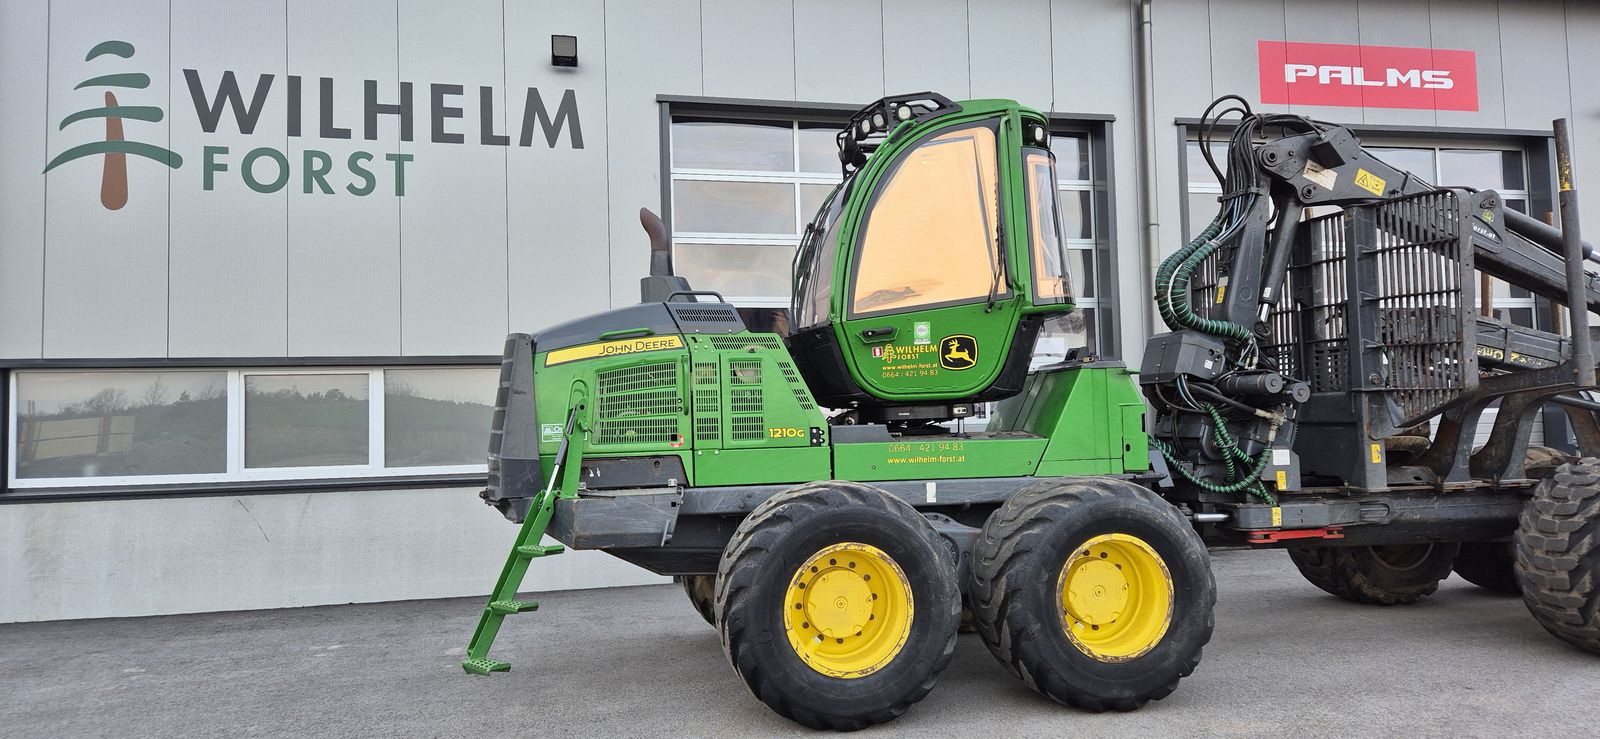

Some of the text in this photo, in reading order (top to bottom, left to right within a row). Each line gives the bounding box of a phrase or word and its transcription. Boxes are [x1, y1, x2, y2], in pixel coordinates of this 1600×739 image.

[1284, 63, 1454, 90] PALMS
[182, 68, 585, 150] WILHELM
[202, 145, 414, 197] FORST
[1472, 222, 1496, 239] orst.at
[598, 339, 675, 355] JOHN DEERE
[895, 344, 938, 354] WILHELM
[768, 428, 805, 438] 1210G
[887, 455, 965, 464] www.wilhelm-forst.at
